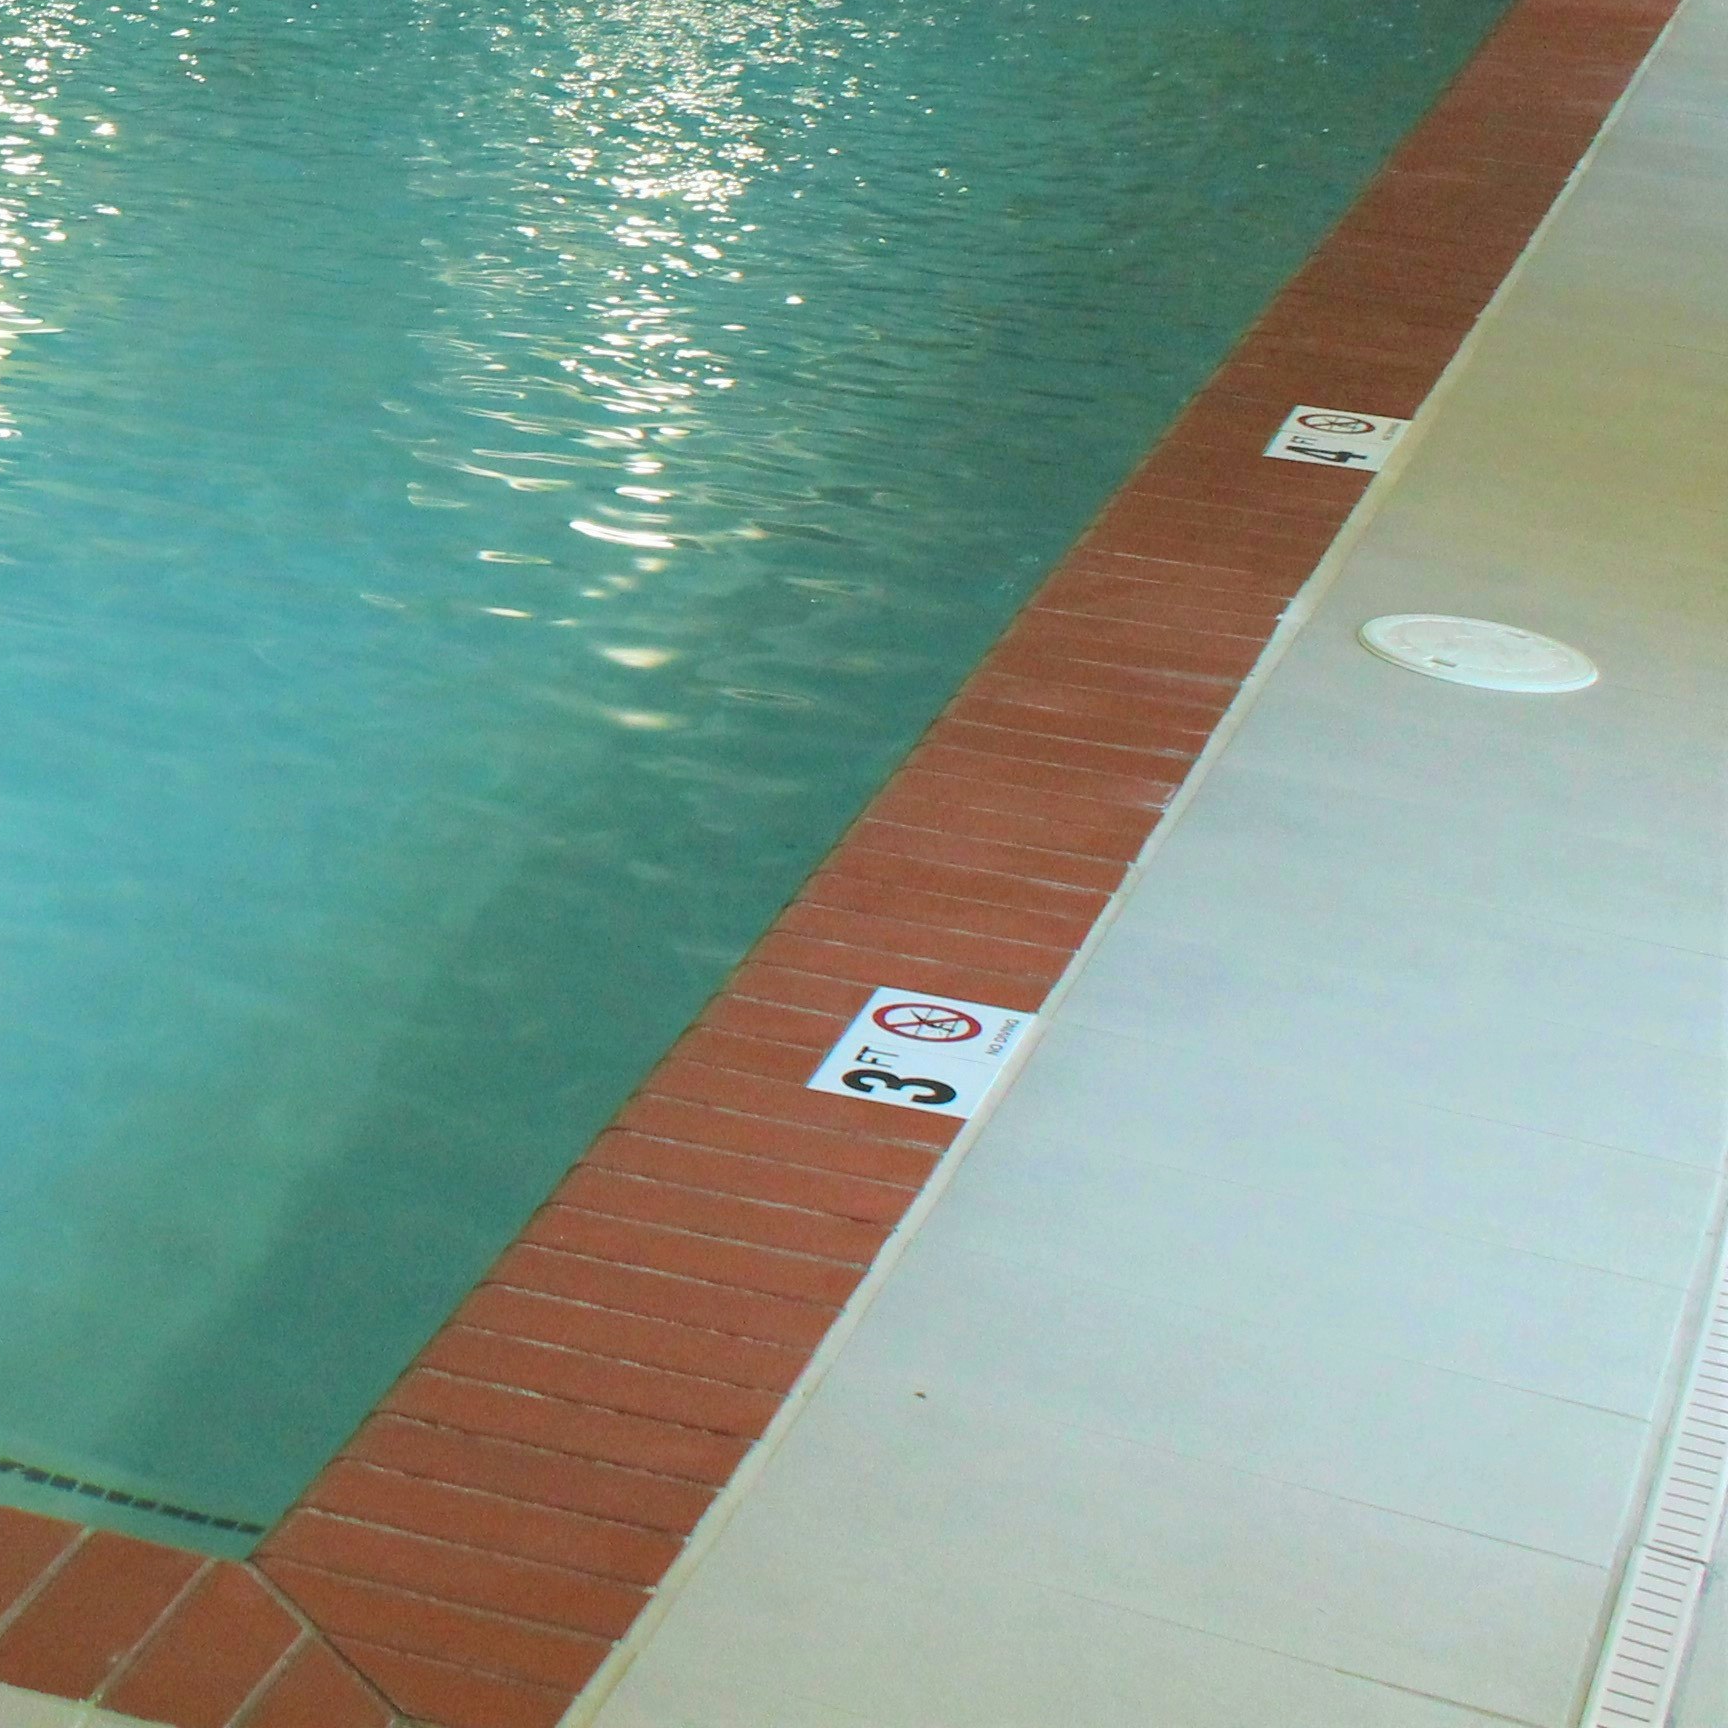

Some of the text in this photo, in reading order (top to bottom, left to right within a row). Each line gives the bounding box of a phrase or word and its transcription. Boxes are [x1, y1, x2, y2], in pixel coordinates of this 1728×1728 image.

[1285, 435, 1369, 463] 4 FT
[984, 1018, 1020, 1056] NO DIVING
[841, 1044, 957, 1106] 3 FT
